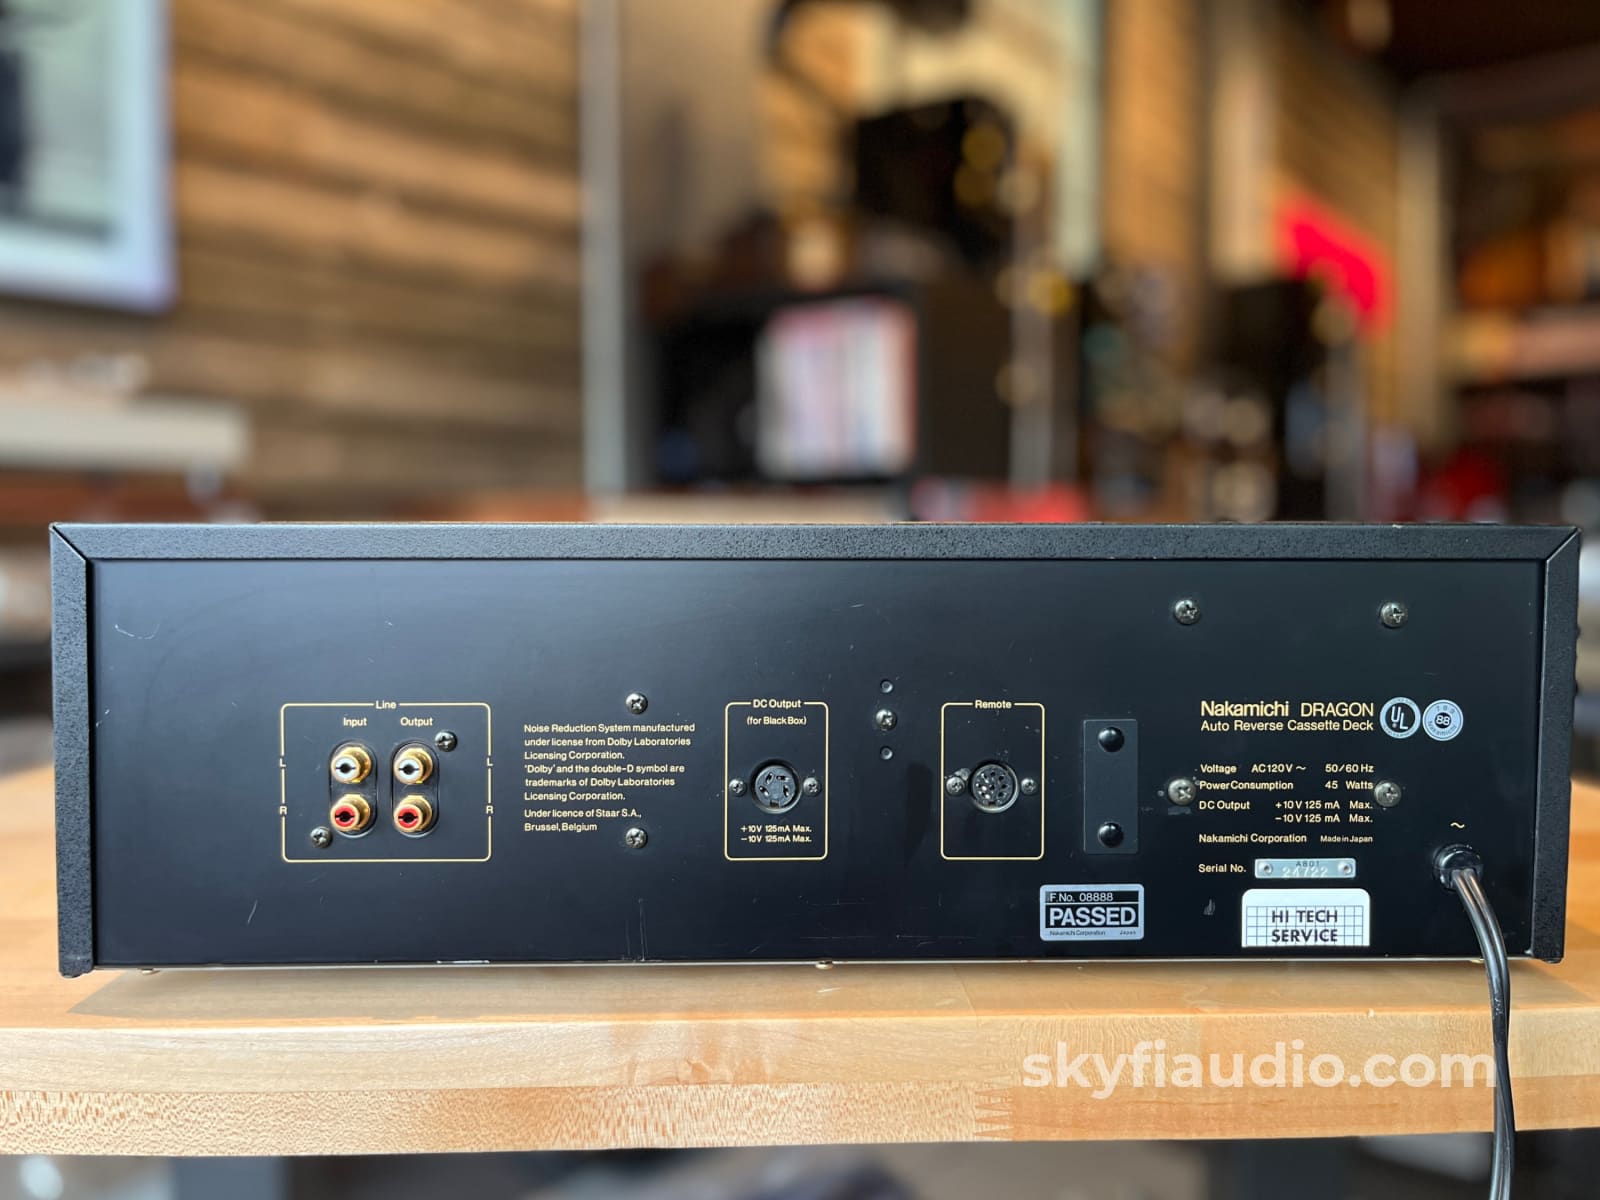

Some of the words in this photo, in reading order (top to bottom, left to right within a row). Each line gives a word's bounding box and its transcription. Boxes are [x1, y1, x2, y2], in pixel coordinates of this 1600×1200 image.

[375, 700, 397, 709] Line
[752, 699, 768, 708] DC
[768, 699, 801, 709] Output
[975, 699, 1012, 710] Remote
[1201, 700, 1290, 717] Nakamichi
[1300, 702, 1374, 717] DRAGON
[343, 717, 367, 728] Input
[400, 717, 433, 727] Output
[746, 716, 762, 725] (for
[763, 716, 788, 725] Black
[787, 716, 807, 725] Box)
[1391, 705, 1409, 730] UL
[1435, 714, 1451, 726] 88
[524, 724, 550, 733] Noise
[551, 723, 597, 732] Reduction
[598, 724, 632, 734] System
[632, 723, 695, 732] manufactured
[1201, 720, 1230, 732] Auto
[1234, 720, 1284, 731] Reverse
[1287, 720, 1340, 731] Cassette
[1342, 720, 1374, 731] Deck
[524, 738, 550, 746] under
[551, 738, 584, 746] license
[585, 737, 606, 746] from
[607, 737, 633, 747] Dolby
[634, 737, 691, 746] Laboratories
[524, 751, 567, 761] Licensing
[568, 751, 625, 761] Corporation.
[279, 758, 286, 767] L
[486, 757, 493, 767] L
[556, 765, 573, 773] and
[575, 765, 590, 773] the
[591, 764, 634, 773] double-D
[635, 764, 668, 774] symbol
[1200, 763, 1237, 774] Voltage
[1324, 763, 1359, 773] 50/60
[1360, 764, 1375, 773] Hz
[525, 778, 577, 787] trademarks
[579, 778, 588, 786] of
[590, 778, 617, 788] Dolby
[617, 777, 675, 786] Laboratories
[1199, 781, 1230, 790] Power
[1230, 781, 1294, 791] Consumption
[1324, 780, 1339, 789] 45
[1345, 780, 1374, 789] Watts
[524, 792, 567, 802] Licensing
[568, 792, 626, 802] Corporation.
[279, 806, 287, 815] R
[486, 805, 494, 814] R
[1199, 801, 1215, 810] DC
[1216, 800, 1250, 811] Output
[1304, 800, 1322, 809] 125
[1324, 801, 1341, 809] mA
[1349, 800, 1373, 809] Max.
[524, 809, 551, 818] Under
[552, 809, 584, 818] licence
[585, 809, 595, 817] of
[595, 809, 620, 818] Staar
[1304, 814, 1322, 823] 125
[1324, 814, 1341, 823] mA
[1349, 814, 1373, 823] Max.
[561, 822, 597, 832] Belgium
[740, 825, 762, 833] +10V
[1198, 833, 1249, 843] Nakamichi
[1250, 833, 1307, 844] Corporation
[1320, 835, 1341, 843] Made
[1349, 835, 1373, 844] Japan
[1198, 863, 1227, 873] Serial
[1230, 863, 1247, 873] No.
[1079, 892, 1113, 902] 08888
[1049, 906, 1136, 926] PASSED
[1271, 910, 1290, 924] HI
[1296, 910, 1339, 923] TECH
[1271, 929, 1339, 943] SERVICE
